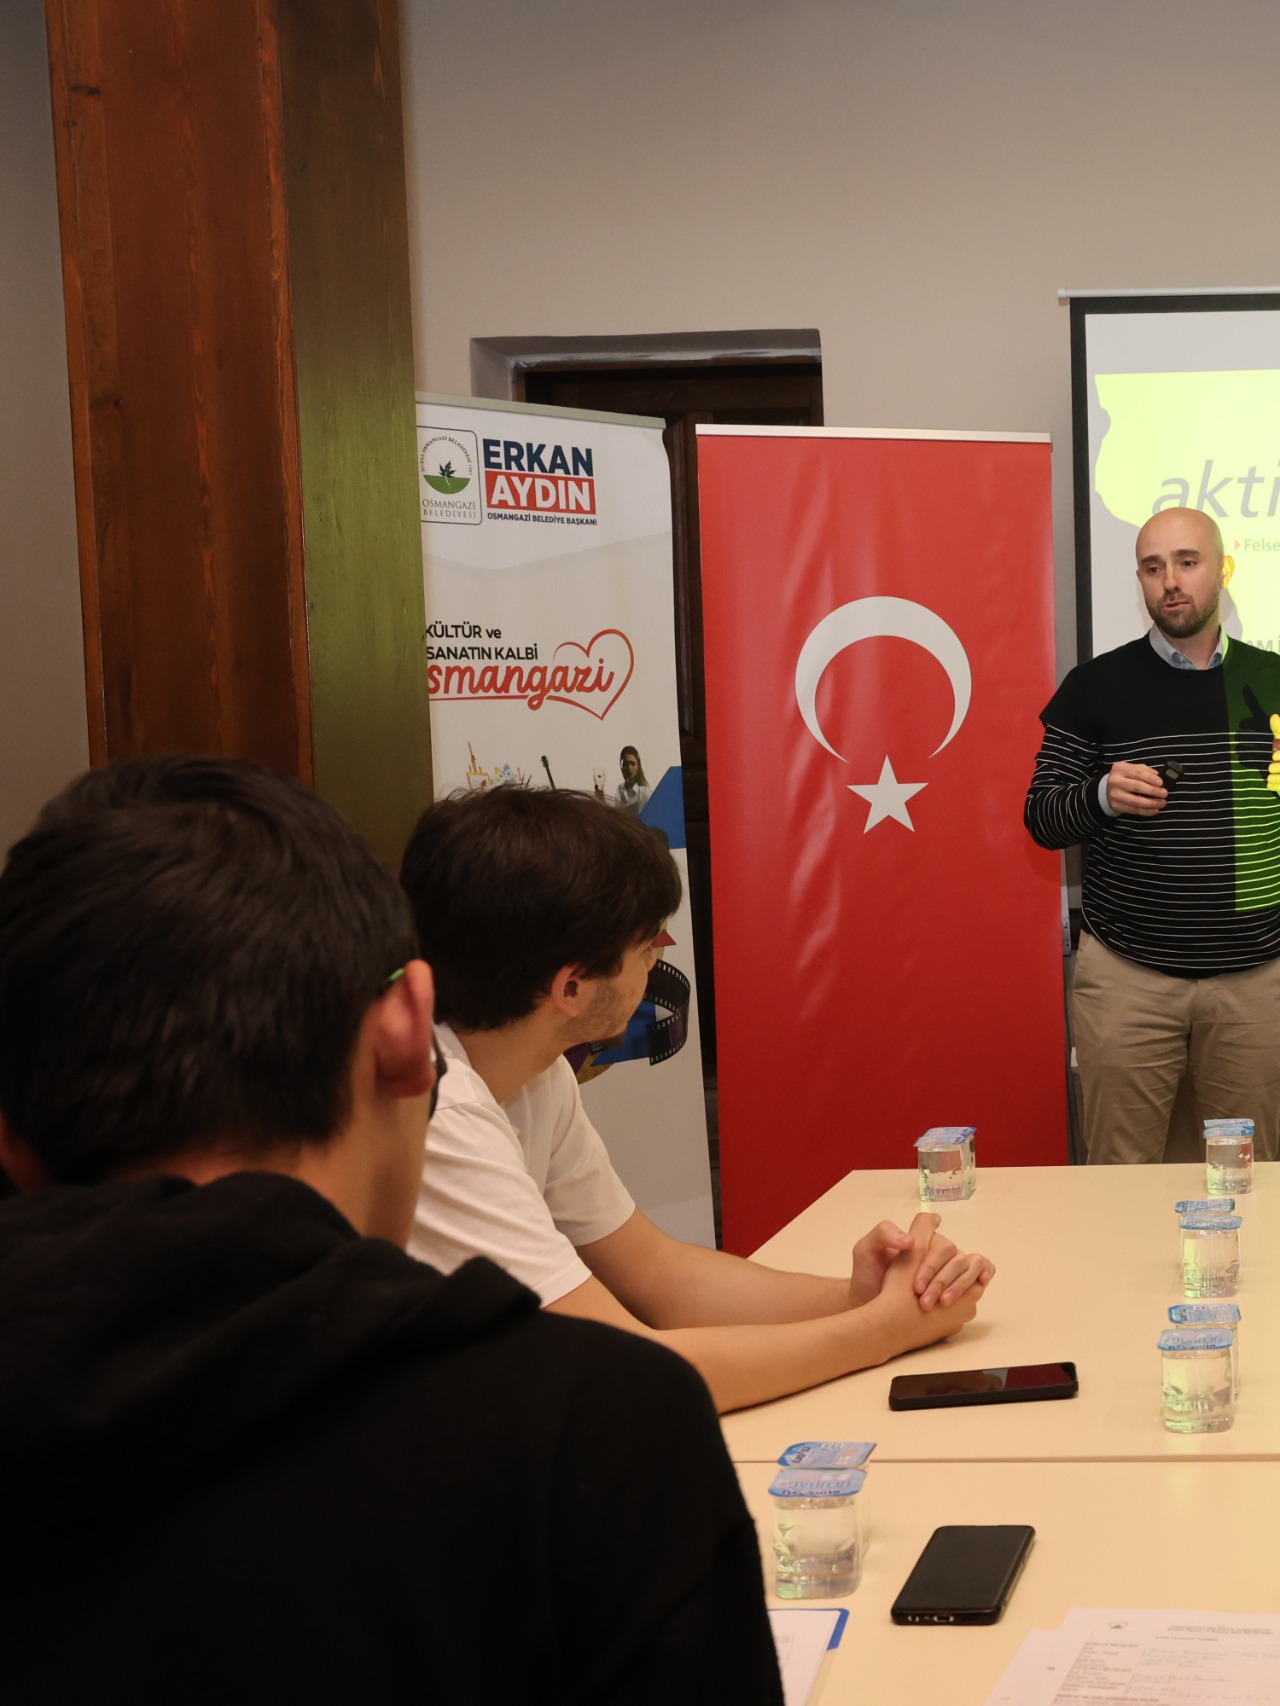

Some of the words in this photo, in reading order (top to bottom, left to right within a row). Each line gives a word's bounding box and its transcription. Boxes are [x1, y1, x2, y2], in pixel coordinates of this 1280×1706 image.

[483, 438, 593, 477] ERKAN
[491, 475, 591, 511] AYDIN
[422, 499, 475, 509] OSMANGAZİ
[423, 508, 476, 518] BELEDİYESİ
[487, 512, 531, 522] OSMANGAZİ
[532, 514, 566, 524] BELEDİYE
[566, 516, 597, 526] BAŞKANI
[426, 621, 482, 638] KÜLTÜR
[486, 628, 501, 639] ve
[427, 646, 492, 660] SANATIN
[495, 643, 538, 660] KALBİ
[428, 658, 615, 710] smangazi
